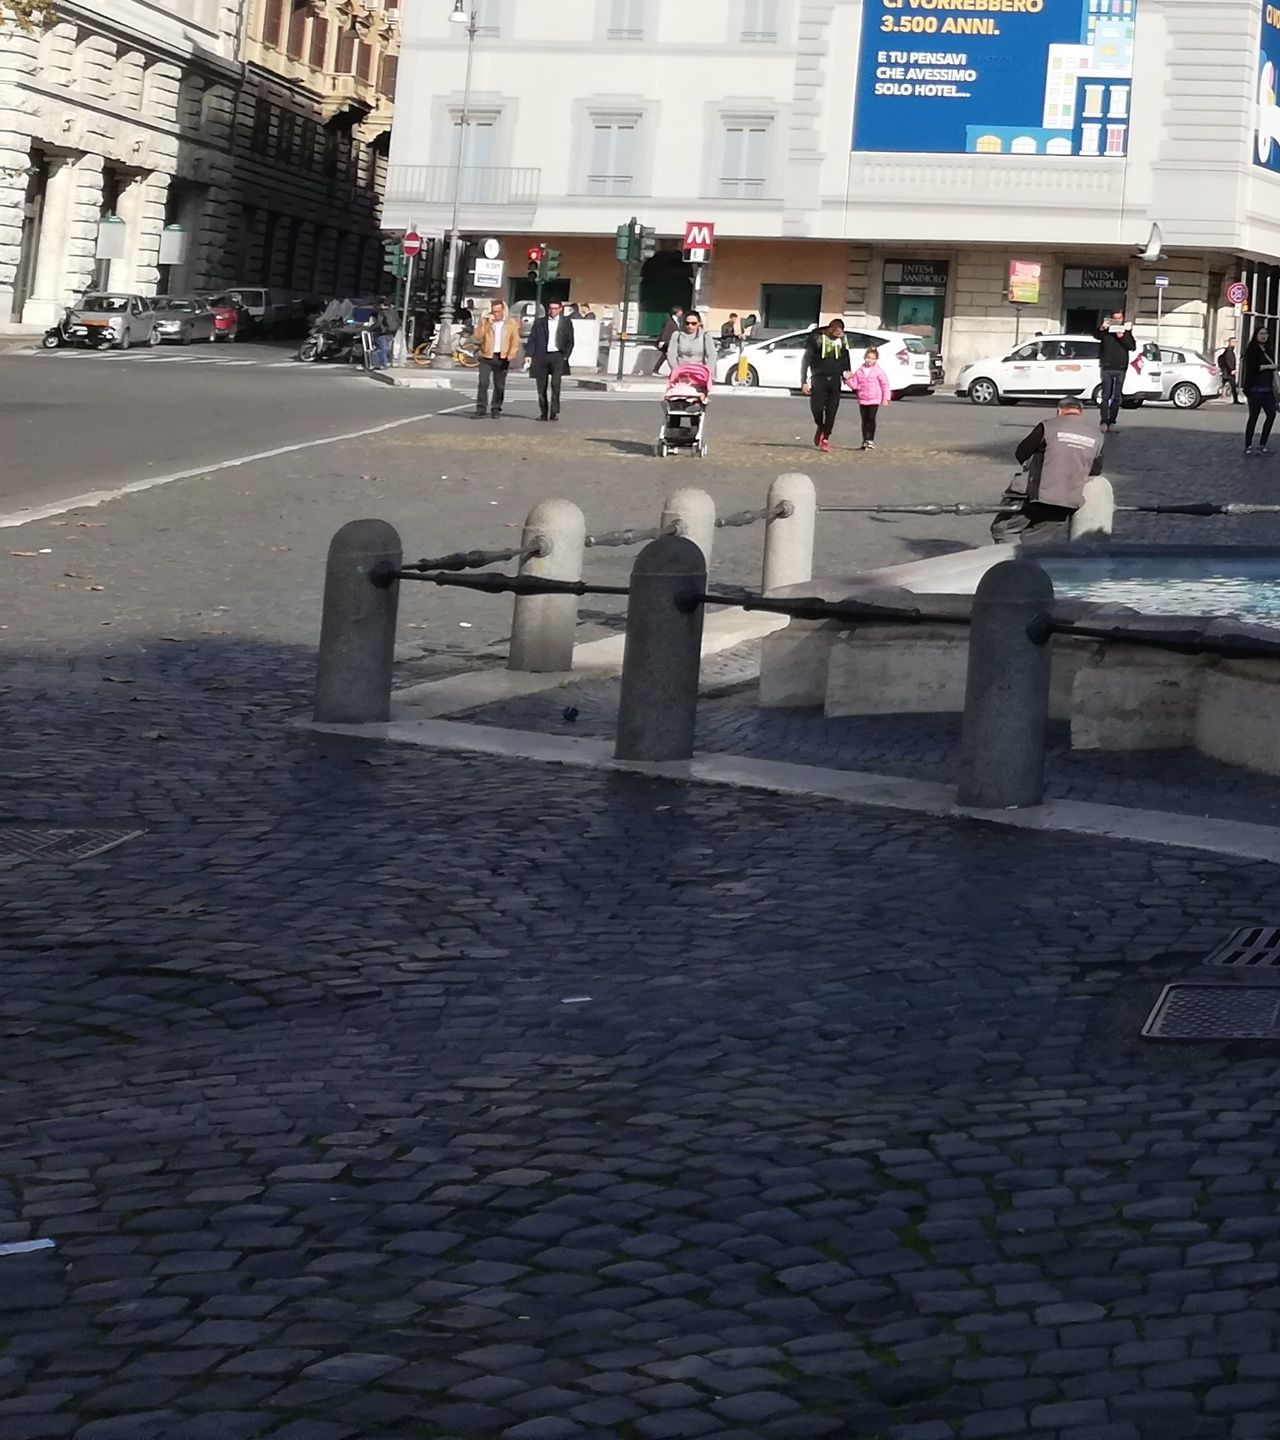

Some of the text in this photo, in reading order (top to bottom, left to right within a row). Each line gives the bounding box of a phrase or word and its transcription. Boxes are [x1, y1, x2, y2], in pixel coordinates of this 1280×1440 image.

[880, 15, 1000, 35] 3.500 ANNI.
[877, 51, 967, 65] E TU PENSAVI
[876, 67, 977, 82] CHE AVESSIMO
[874, 83, 971, 98] SOLO HOTEL...
[687, 226, 711, 244] M
[904, 264, 934, 275] INTESA
[1083, 270, 1115, 280] INTESA
